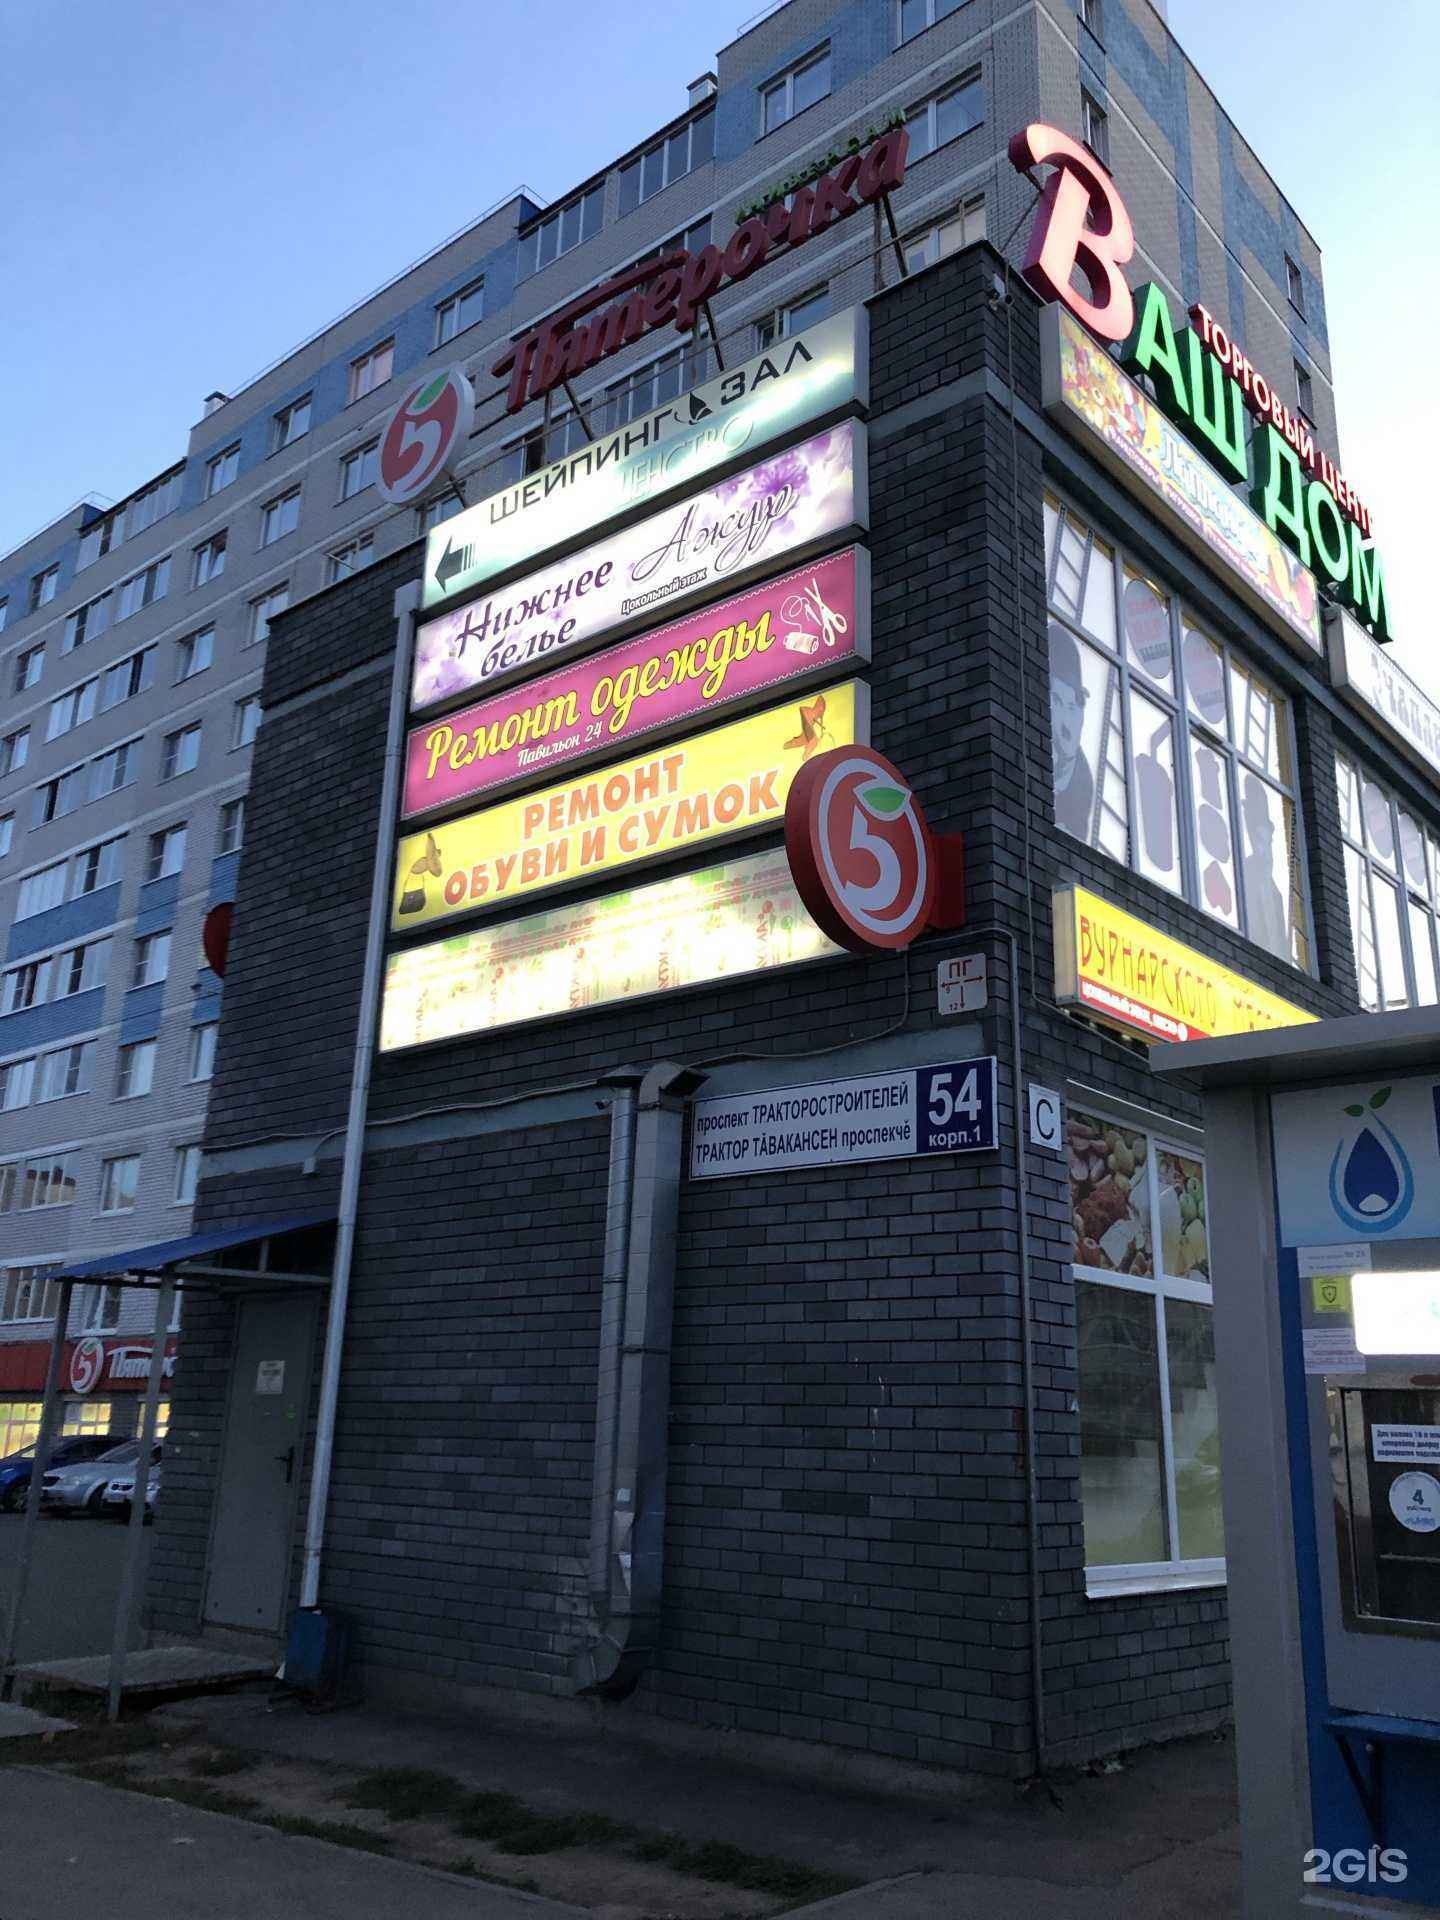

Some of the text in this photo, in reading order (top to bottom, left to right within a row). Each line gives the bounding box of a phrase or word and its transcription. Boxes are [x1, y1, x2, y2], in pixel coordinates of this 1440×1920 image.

[491, 128, 909, 415] Пятерочка
[1010, 123, 1248, 483] ВАШ
[1255, 424, 1393, 642] ДОМ
[1190, 303, 1316, 469] ТОРГОВЫЙ
[490, 341, 813, 525] ШЕЙПИНГ ЗАЛ
[631, 484, 797, 582] Ажур
[455, 561, 613, 659] Нижнее
[621, 567, 707, 615] Цокольный этаж
[480, 618, 577, 677] белье
[425, 610, 777, 780] Ремонт одежды
[518, 720, 603, 768] Павильон 24
[443, 768, 783, 906] ОБУВИ И СУМОК
[522, 753, 685, 840] РЕМОНТ
[949, 959, 972, 978] ПГ
[697, 1081, 909, 1136] проспект ТРАКТОРОСТРОИТЕЛЕЙ
[928, 1068, 982, 1126] 54
[696, 1138, 750, 1164] ТРАКТОР
[1412, 1488, 1424, 1505] 4
